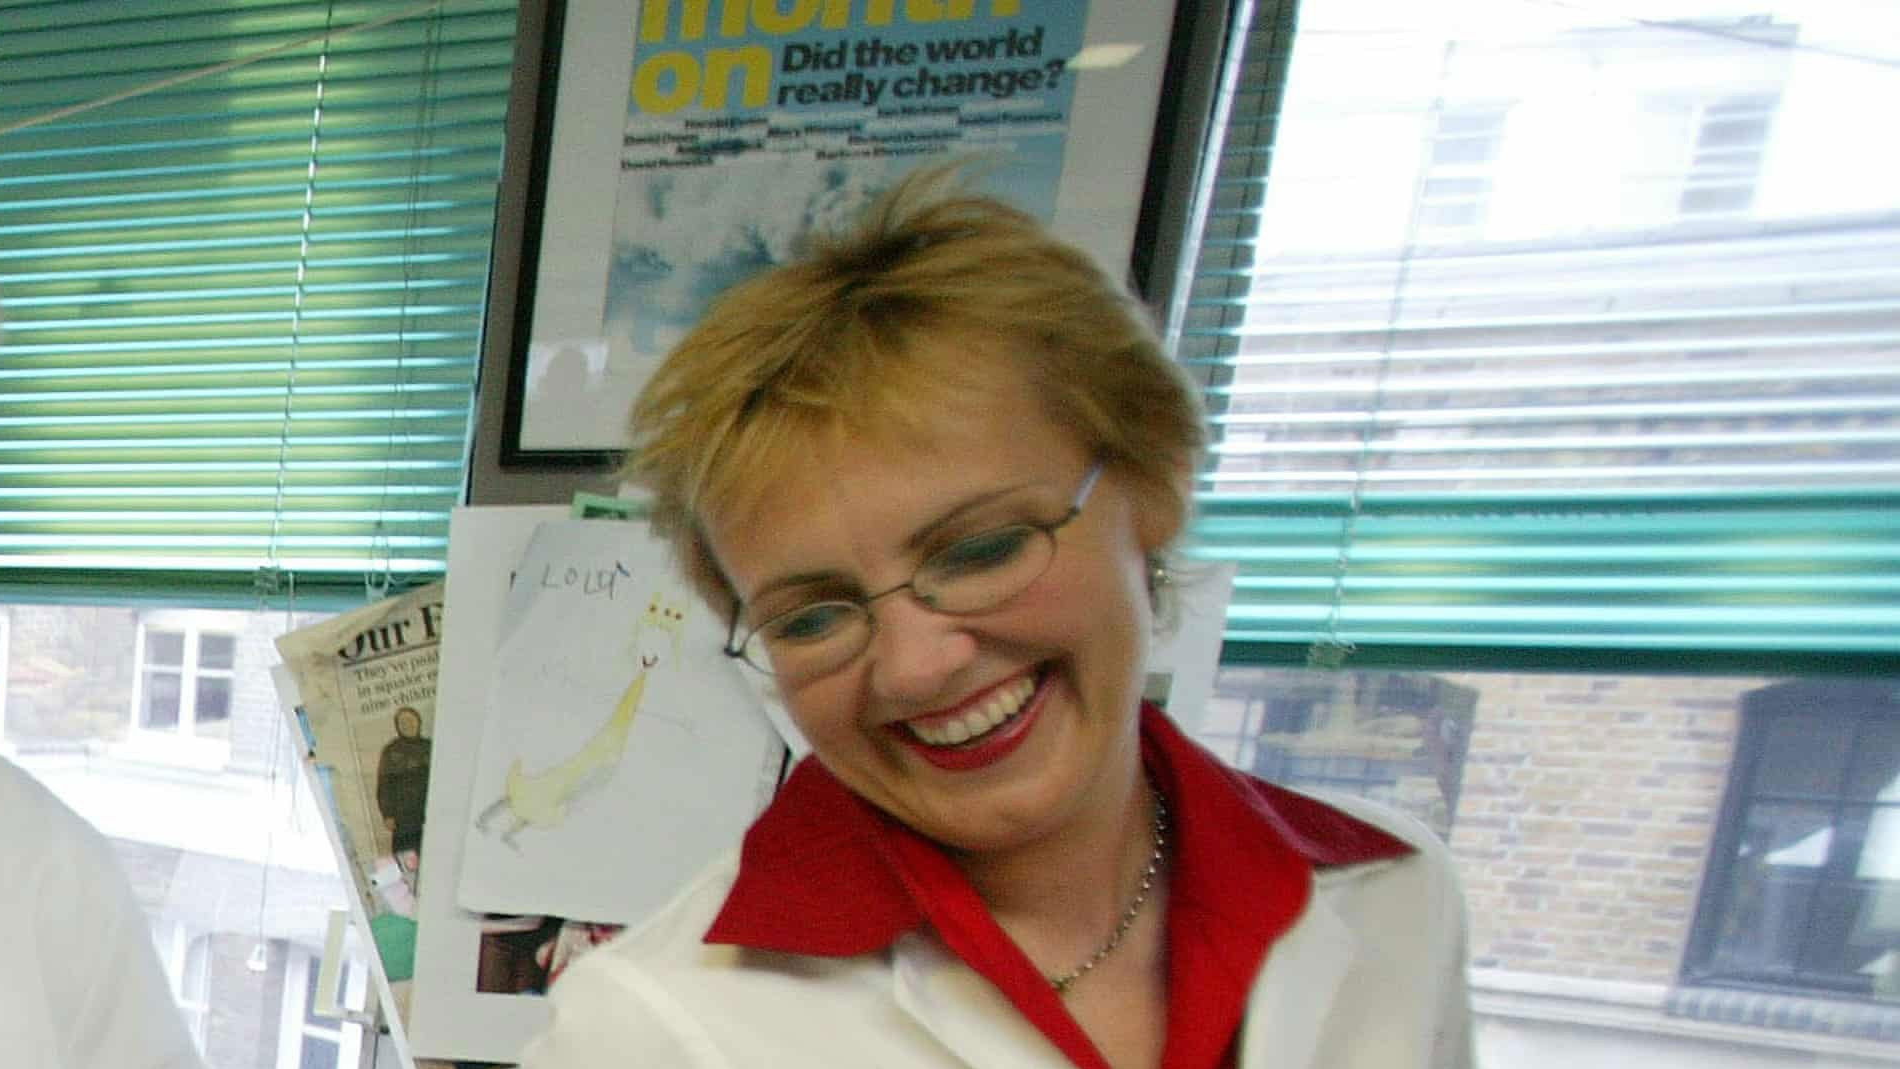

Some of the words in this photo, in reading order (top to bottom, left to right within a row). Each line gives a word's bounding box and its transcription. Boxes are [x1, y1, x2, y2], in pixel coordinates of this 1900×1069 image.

[782, 38, 849, 72] Did
[855, 38, 918, 67] the
[925, 25, 1045, 63] world
[634, 45, 773, 115] on
[777, 72, 888, 106] really
[891, 58, 1067, 98] change?
